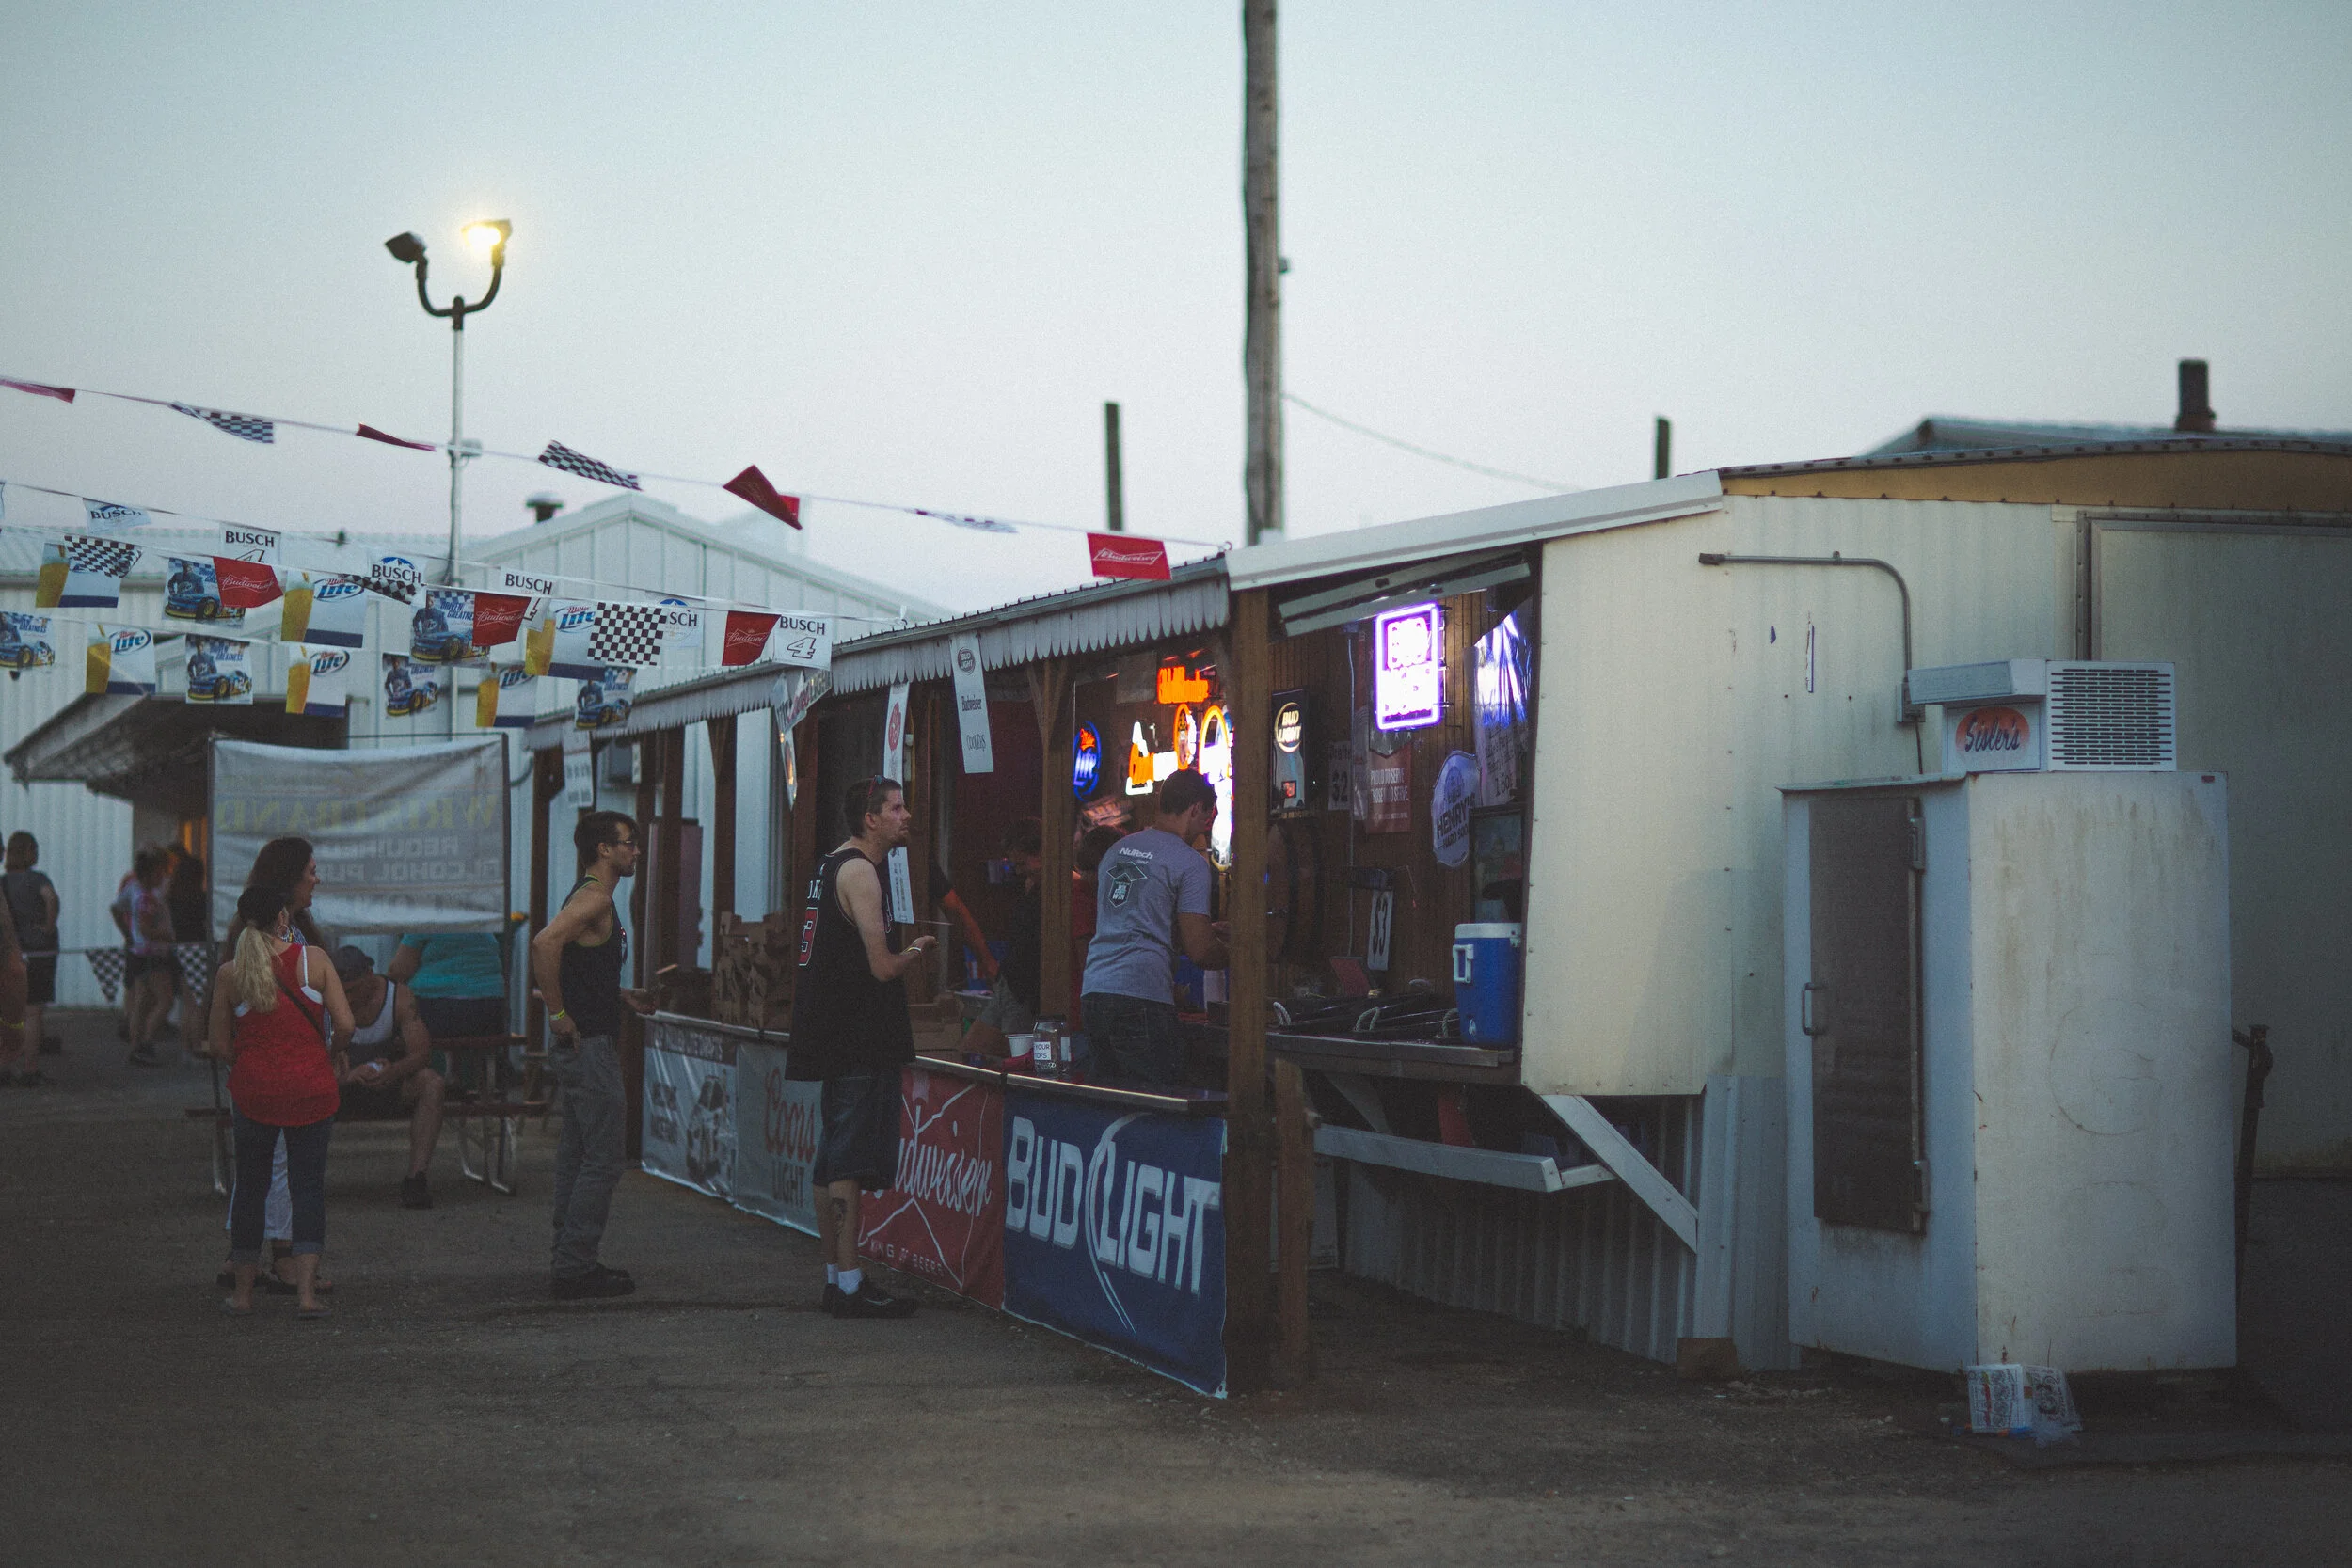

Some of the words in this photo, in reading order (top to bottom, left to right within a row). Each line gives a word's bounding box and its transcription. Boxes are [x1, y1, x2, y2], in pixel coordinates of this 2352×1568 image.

[90, 509, 142, 520] BUSCH
[225, 530, 275, 548] BUSCH
[1099, 548, 1160, 563] Budweiser
[372, 564, 421, 584] BUSCH
[315, 582, 358, 599] Lite
[505, 573, 553, 595] BUSCH
[447, 610, 474, 621] GREATNE
[559, 610, 596, 630] Lite
[669, 611, 698, 627] SCH
[779, 616, 826, 636] BUSCH
[114, 635, 145, 654] Lite
[787, 636, 817, 659] 4
[312, 657, 344, 675] Lite
[1281, 709, 1300, 726] BUD
[1279, 726, 1302, 743] LIGHT
[1964, 713, 2021, 753] Sisler's
[1436, 791, 1476, 840] HENRY'S
[1119, 847, 1154, 860] NuTech
[764, 1067, 817, 1164] Coors
[771, 1159, 805, 1209] LIGHT
[1005, 1115, 1084, 1251] BUD
[1095, 1139, 1221, 1302] LIGHT
